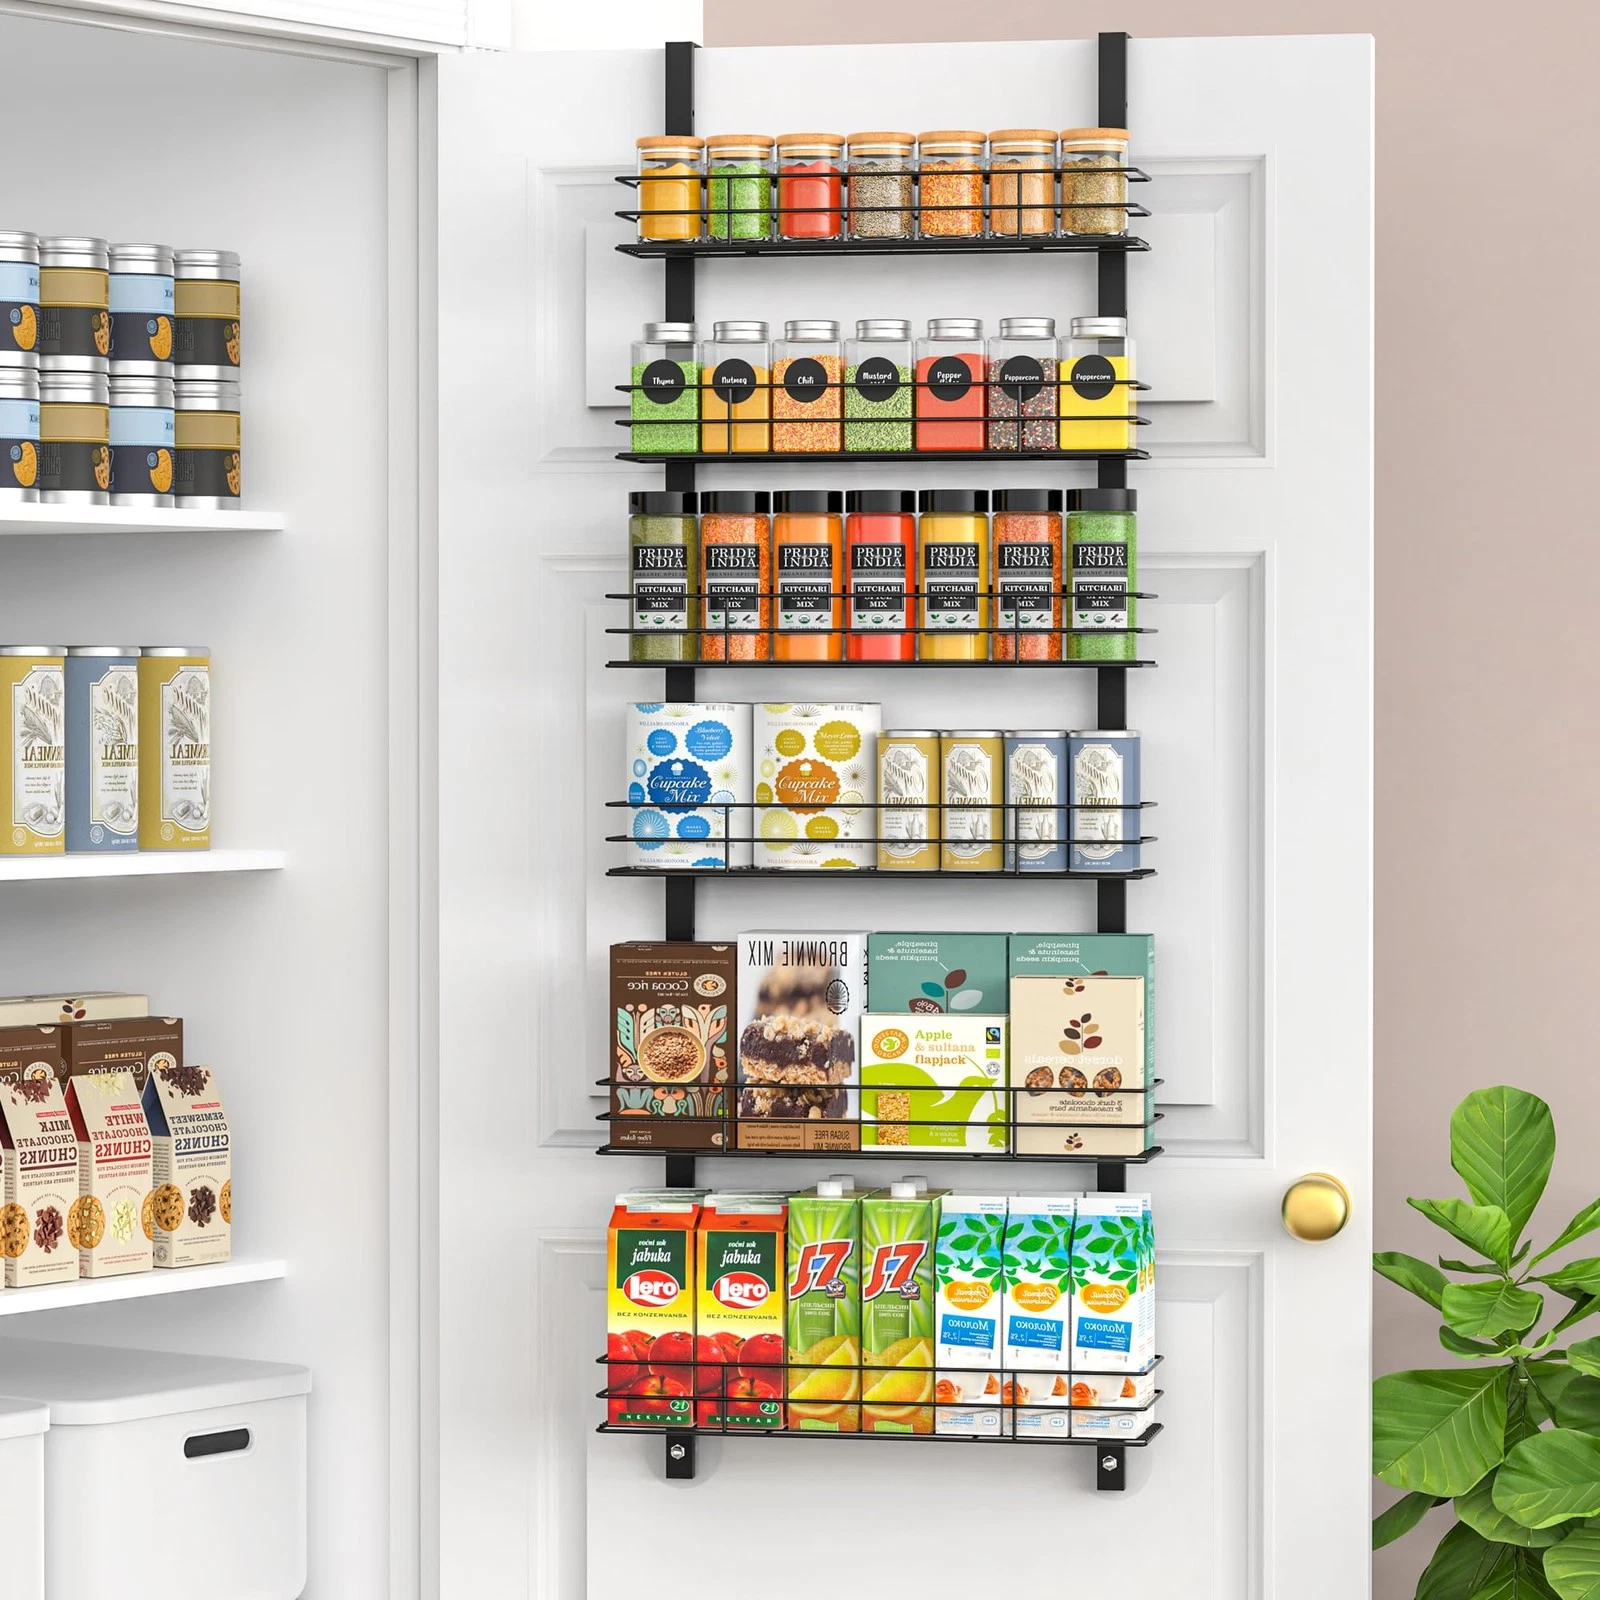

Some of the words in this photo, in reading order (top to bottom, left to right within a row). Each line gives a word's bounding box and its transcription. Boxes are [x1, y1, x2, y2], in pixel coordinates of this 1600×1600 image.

[653, 377, 674, 385] Thyme
[797, 376, 814, 384] Chili
[937, 371, 962, 380] Pepper
[1076, 373, 1111, 381] Peppercorn
[639, 548, 683, 558] PRIDE
[712, 548, 756, 558] PRIDE
[784, 548, 828, 558] PRIDE
[857, 547, 902, 557] PRIDE
[930, 546, 975, 557] PRIDE
[1004, 546, 1049, 557] PRIDE
[1079, 546, 1124, 556] PRIDE
[650, 776, 706, 790] Cupcake
[778, 776, 835, 790] Cupcake
[665, 789, 700, 803] Mix
[794, 789, 829, 803] Mix
[915, 1030, 952, 1041] Apple
[877, 1044, 906, 1058] ORGANIC
[915, 1043, 924, 1052] &
[928, 1042, 975, 1052] sultana
[915, 1055, 966, 1066] flapjack
[630, 1248, 672, 1266] jabuka
[720, 1250, 761, 1267] jabuka
[790, 1240, 854, 1300] J7
[864, 1241, 928, 1301] J7
[630, 1276, 677, 1299] Lero
[719, 1278, 767, 1301] Lero
